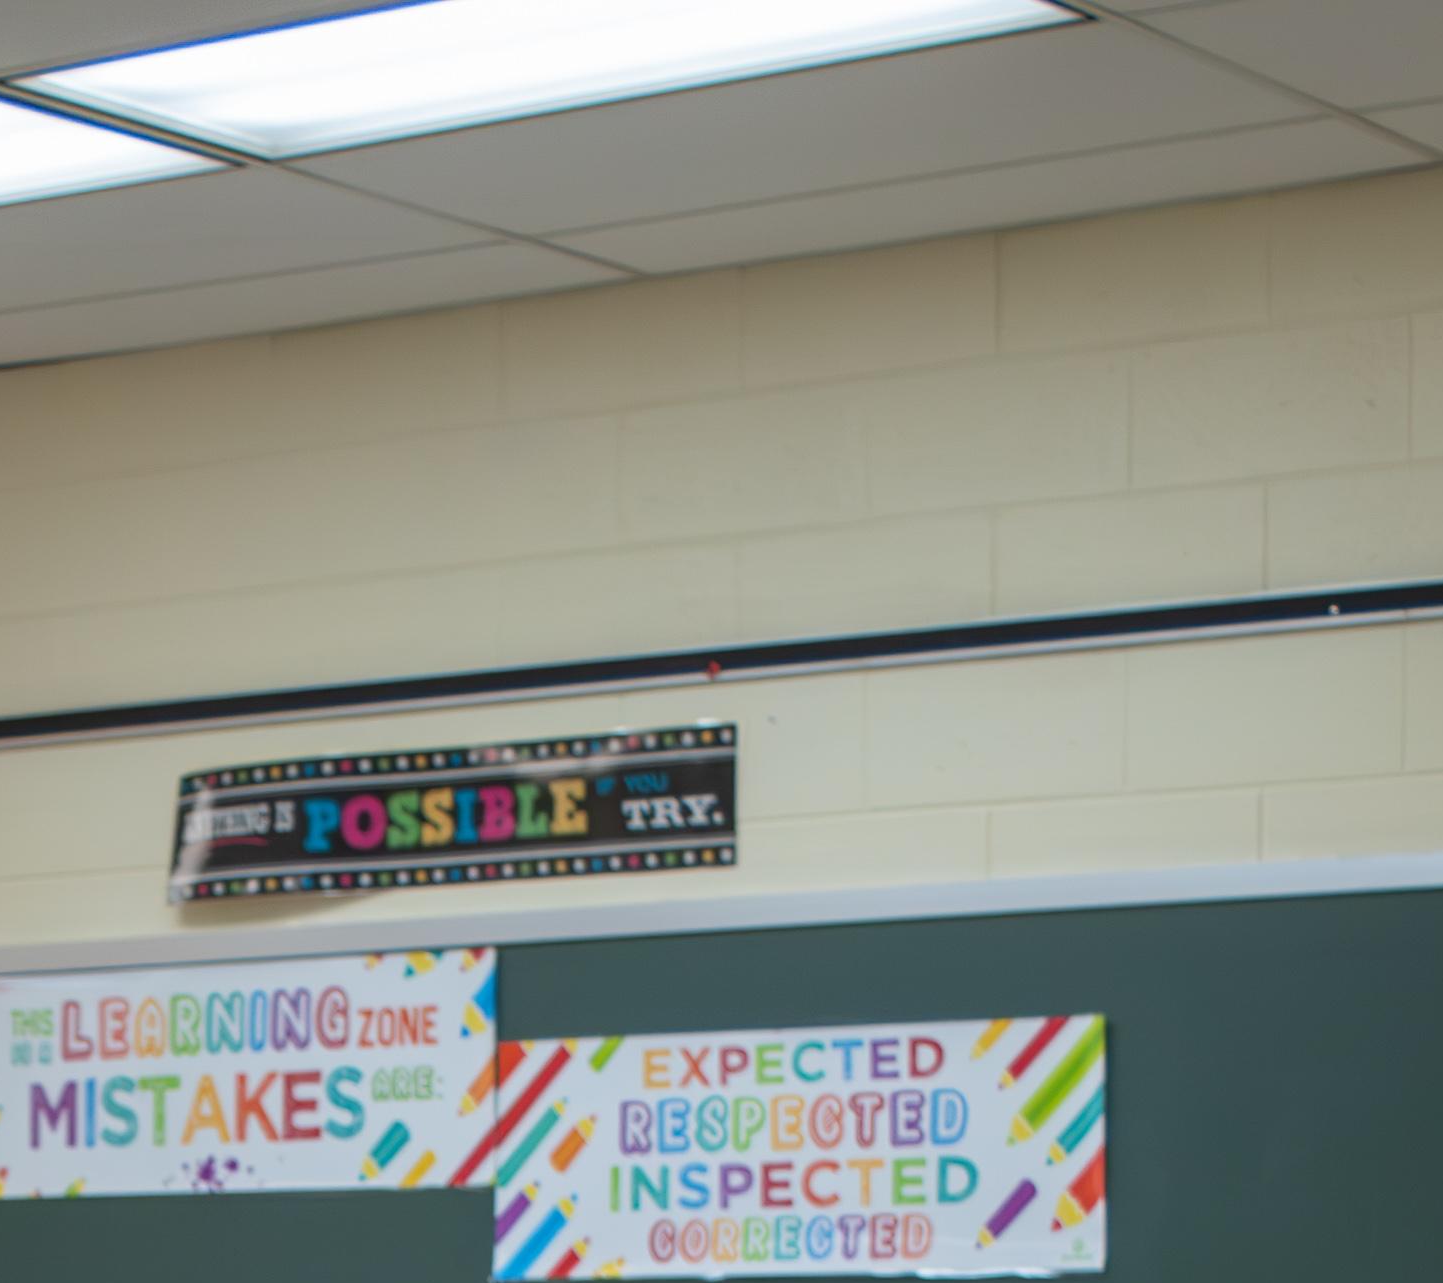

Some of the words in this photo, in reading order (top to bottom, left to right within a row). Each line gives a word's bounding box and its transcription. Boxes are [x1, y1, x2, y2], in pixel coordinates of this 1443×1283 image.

[304, 779, 587, 852] POSSIBLE
[624, 772, 669, 794] YOU
[621, 793, 724, 830] TRY.
[11, 1008, 54, 1037] THIS
[61, 986, 350, 1061] LEARNING
[358, 1005, 439, 1048] ZONE
[643, 1037, 944, 1088] EXPECTED
[30, 1067, 364, 1149] MISTAKES
[620, 1089, 968, 1154] RESPECTED
[610, 1156, 978, 1211] INSPECTED
[650, 1214, 931, 1262] CORRECTED
